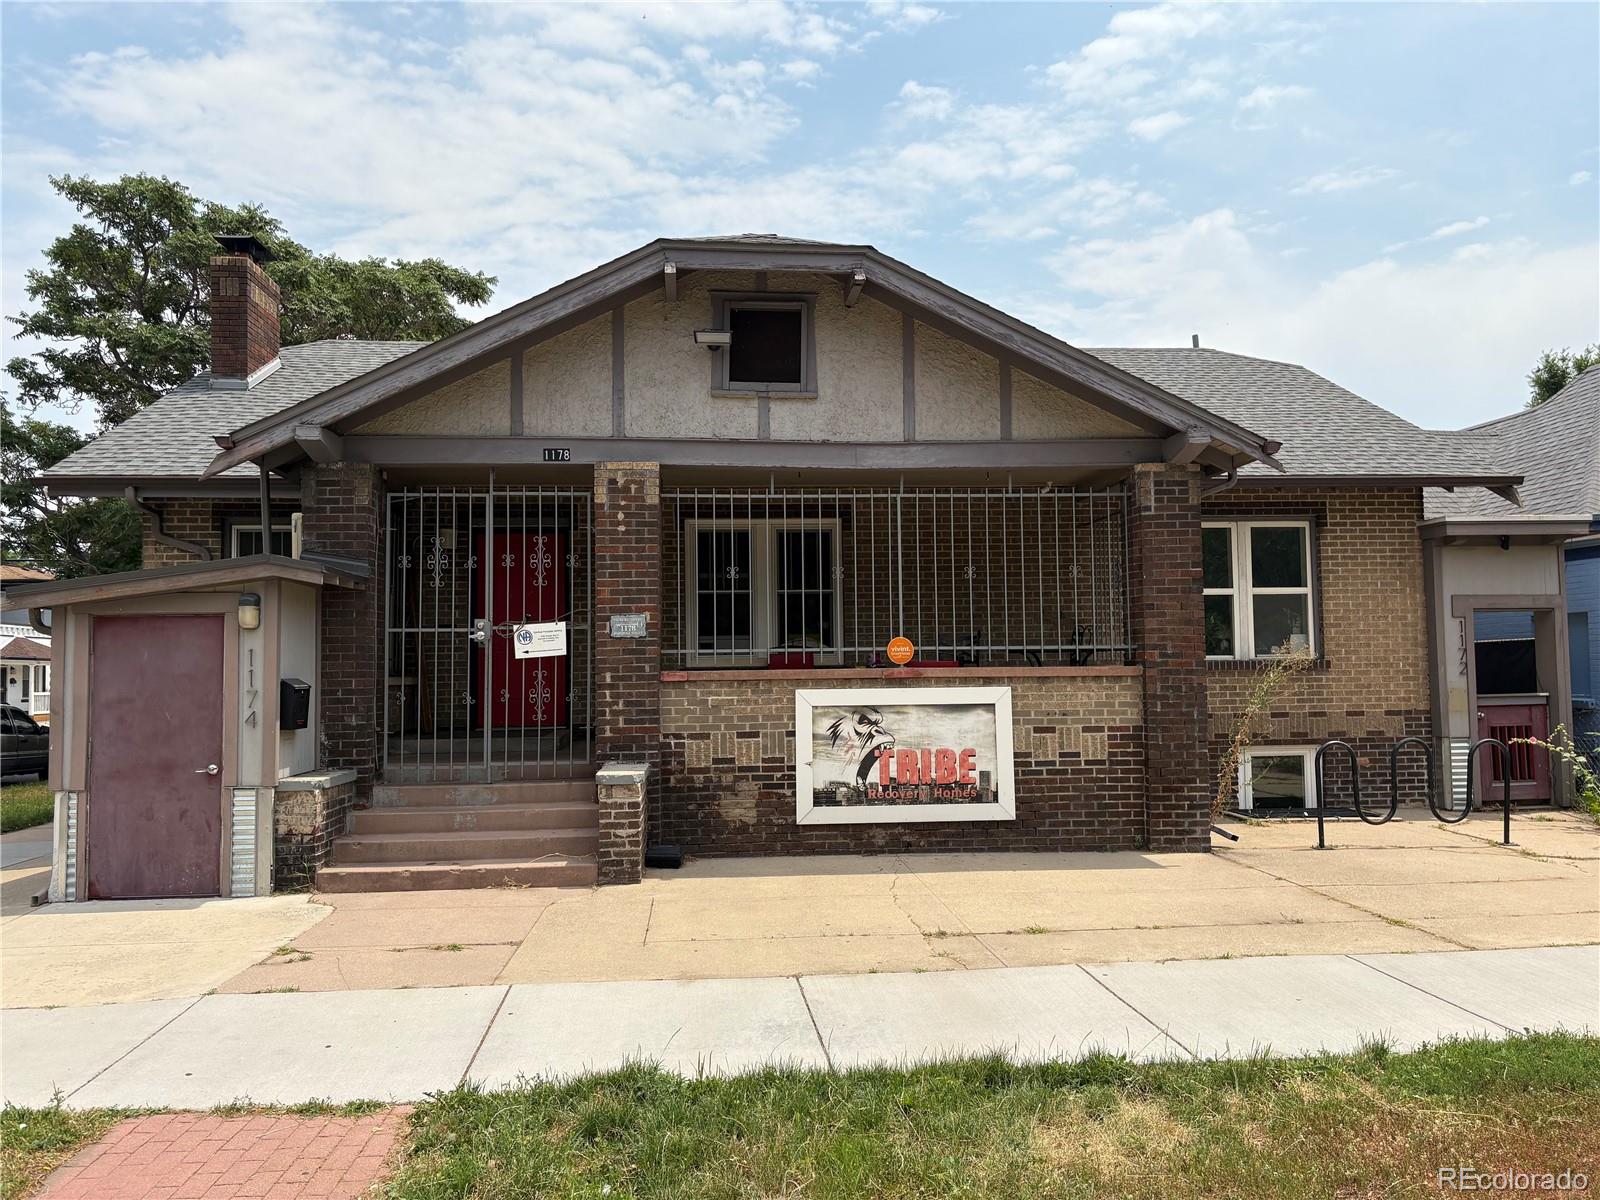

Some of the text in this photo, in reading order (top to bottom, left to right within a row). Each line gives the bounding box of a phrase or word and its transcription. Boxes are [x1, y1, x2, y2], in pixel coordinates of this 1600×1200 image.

[545, 450, 570, 460] 1178
[1458, 620, 1467, 675] 1172
[245, 649, 258, 728] 1174
[874, 748, 977, 786] TRIBE
[868, 788, 977, 801] Recovery Homes
